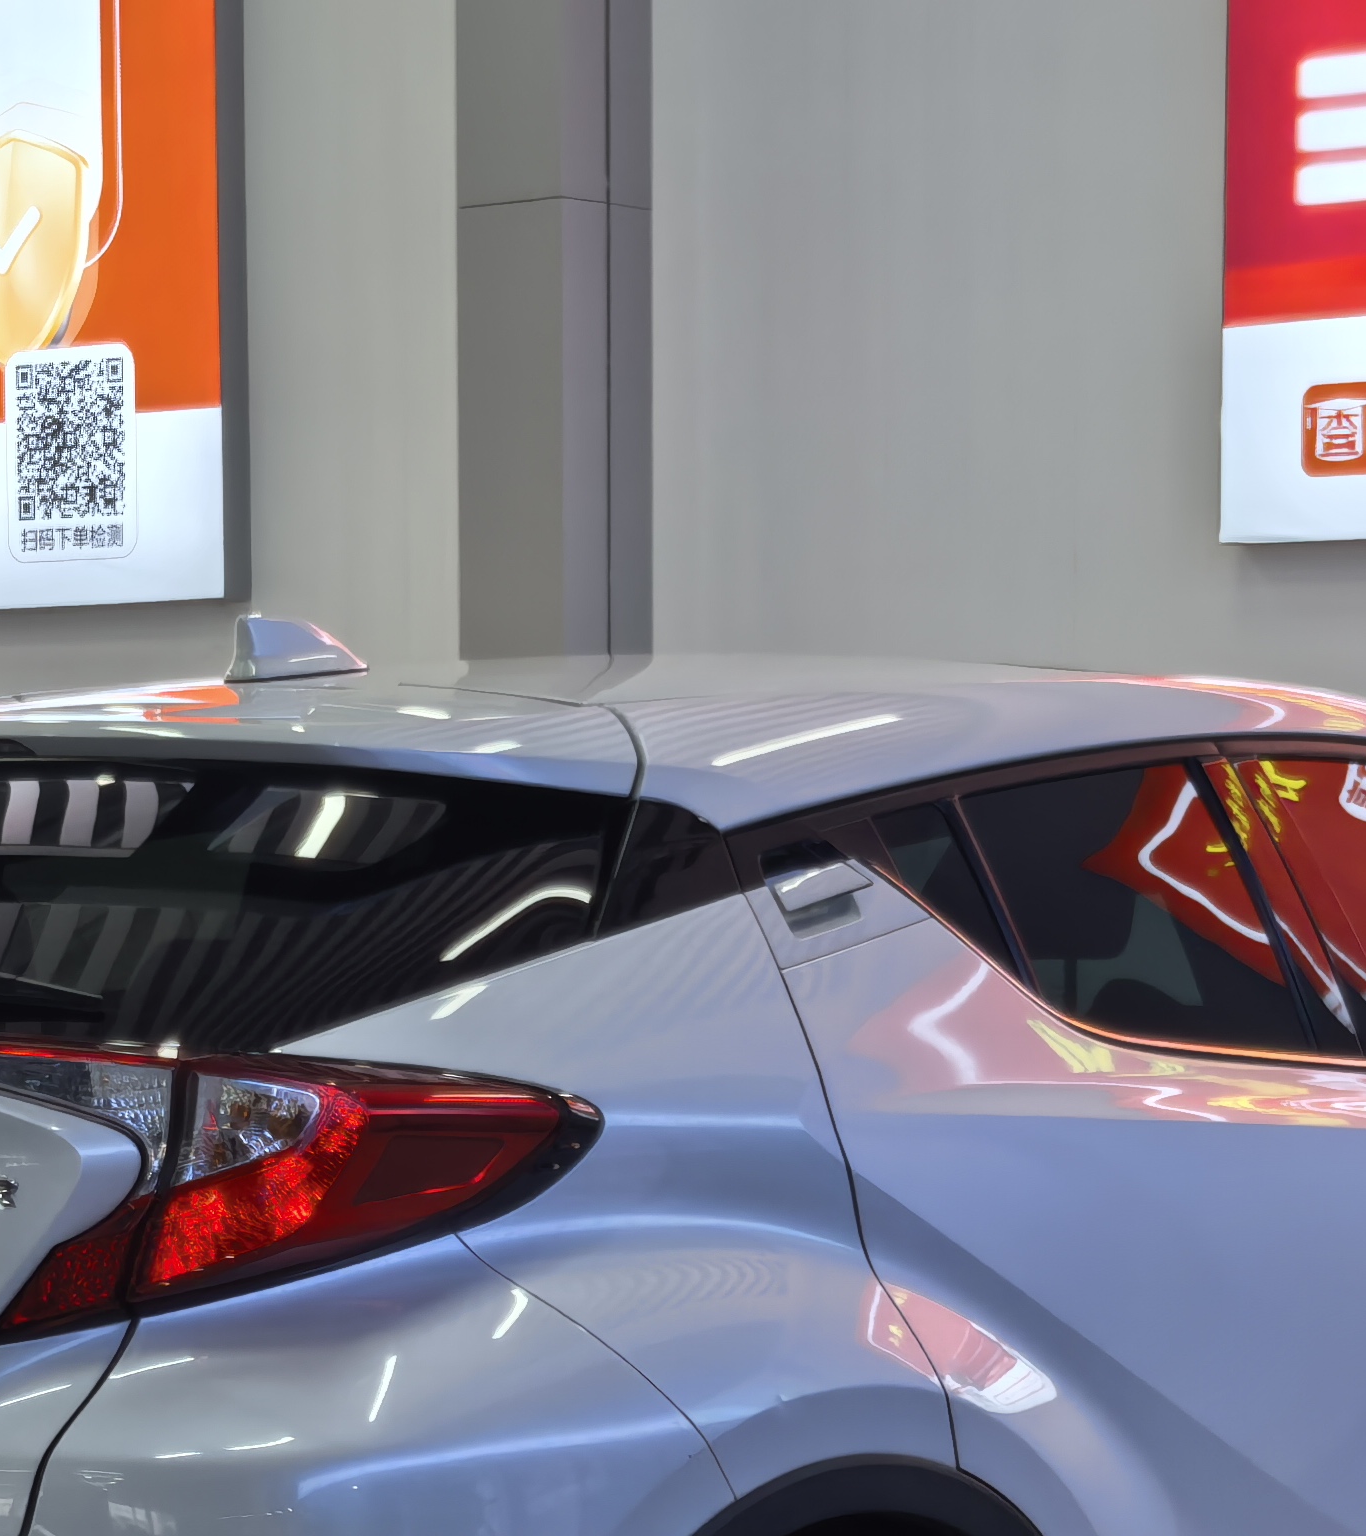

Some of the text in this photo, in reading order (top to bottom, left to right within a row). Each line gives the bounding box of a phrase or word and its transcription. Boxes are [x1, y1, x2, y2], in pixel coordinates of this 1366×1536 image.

[20, 523, 124, 553] 扫码下单检测
